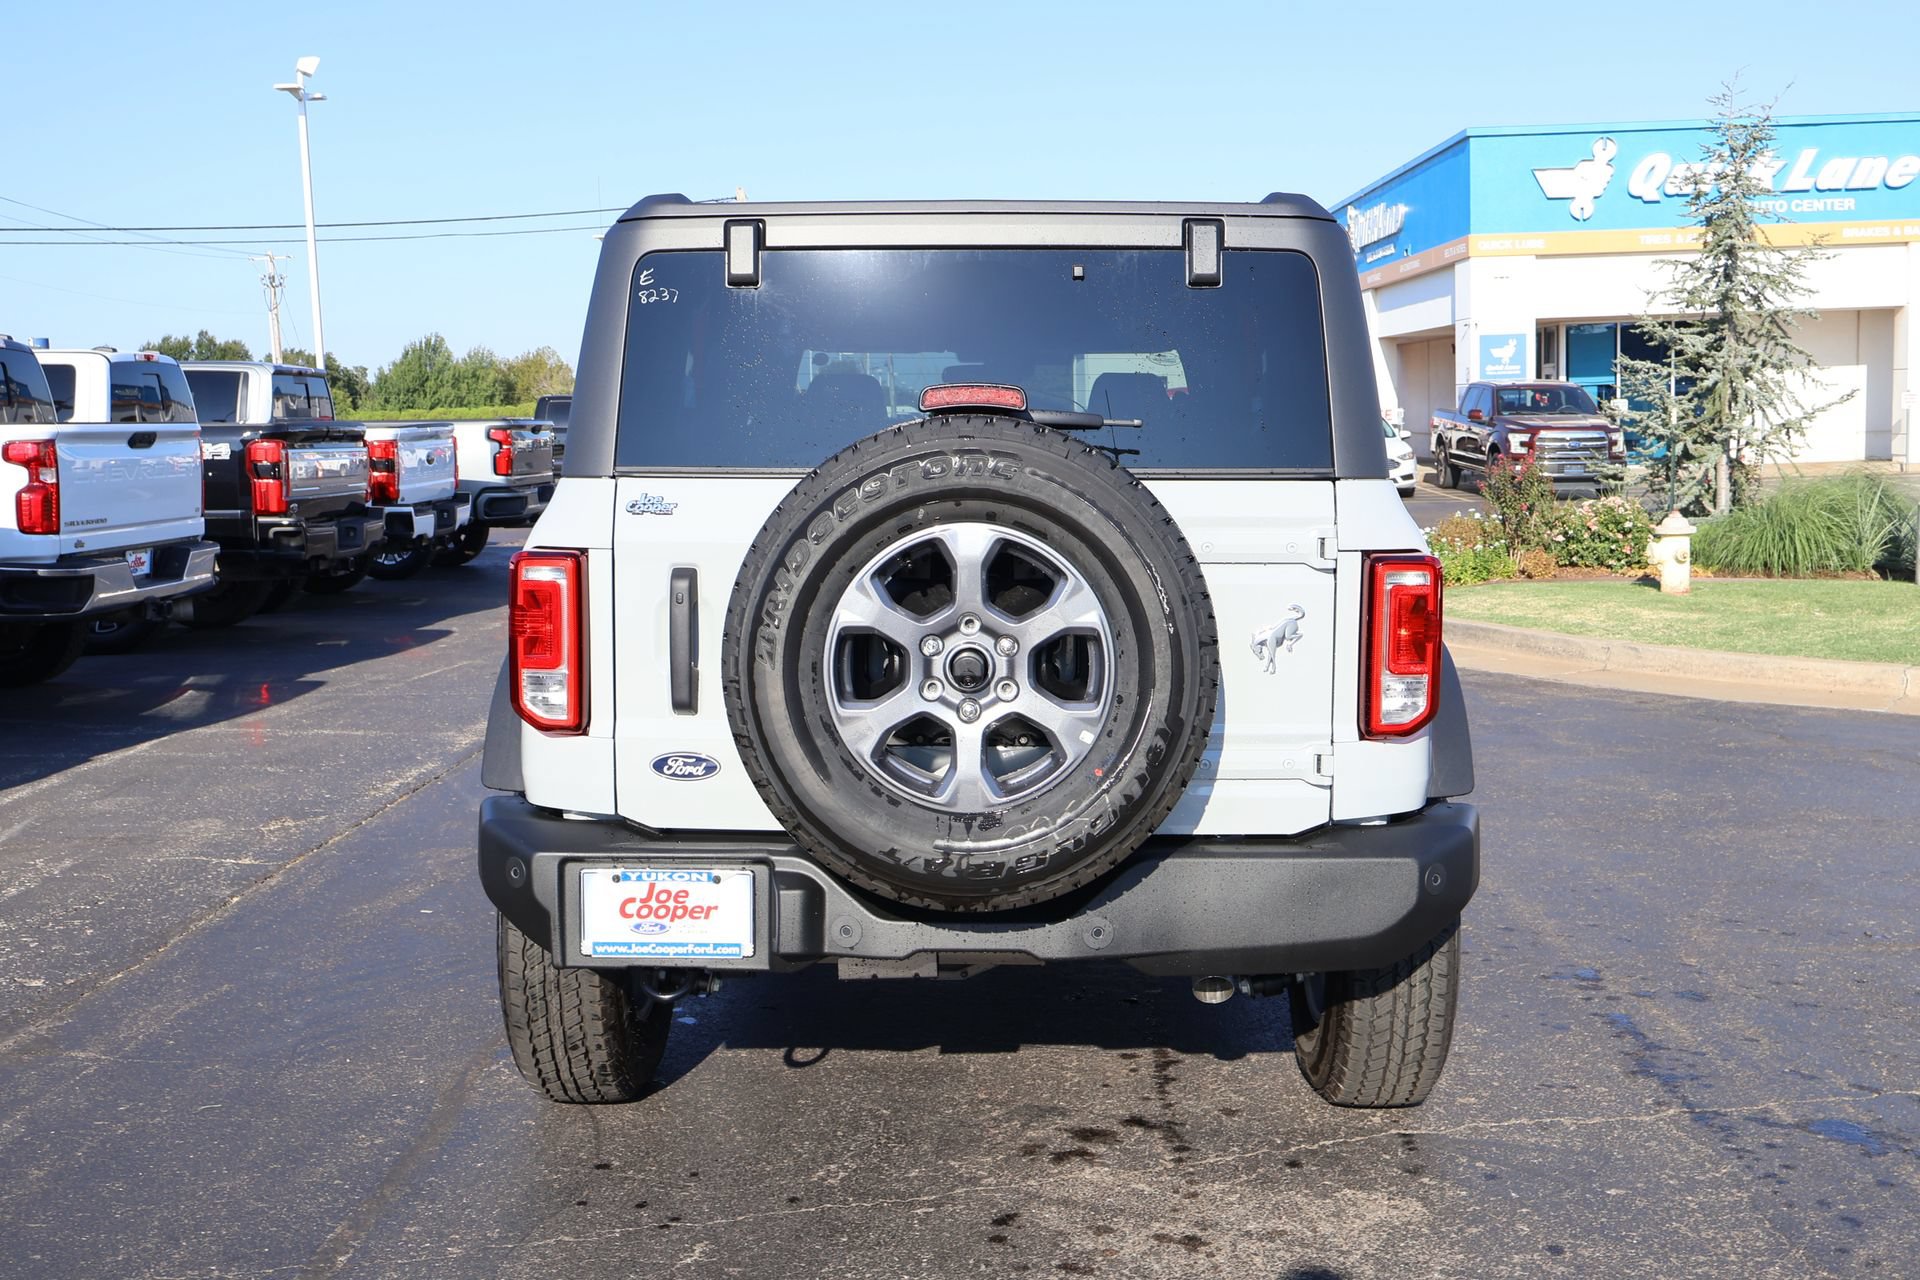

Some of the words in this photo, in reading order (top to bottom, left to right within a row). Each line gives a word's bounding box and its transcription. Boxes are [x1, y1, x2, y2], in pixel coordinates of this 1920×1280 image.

[1781, 147, 1920, 192] Lane
[1791, 198, 1856, 212] CENTER
[638, 288, 679, 304] 8237
[625, 500, 678, 514] Cooper
[755, 448, 1026, 671] BRIDGESTONE
[663, 757, 706, 775] Ford
[624, 872, 709, 881] YUKON
[640, 883, 690, 904] Joe
[618, 897, 719, 922] Cooper
